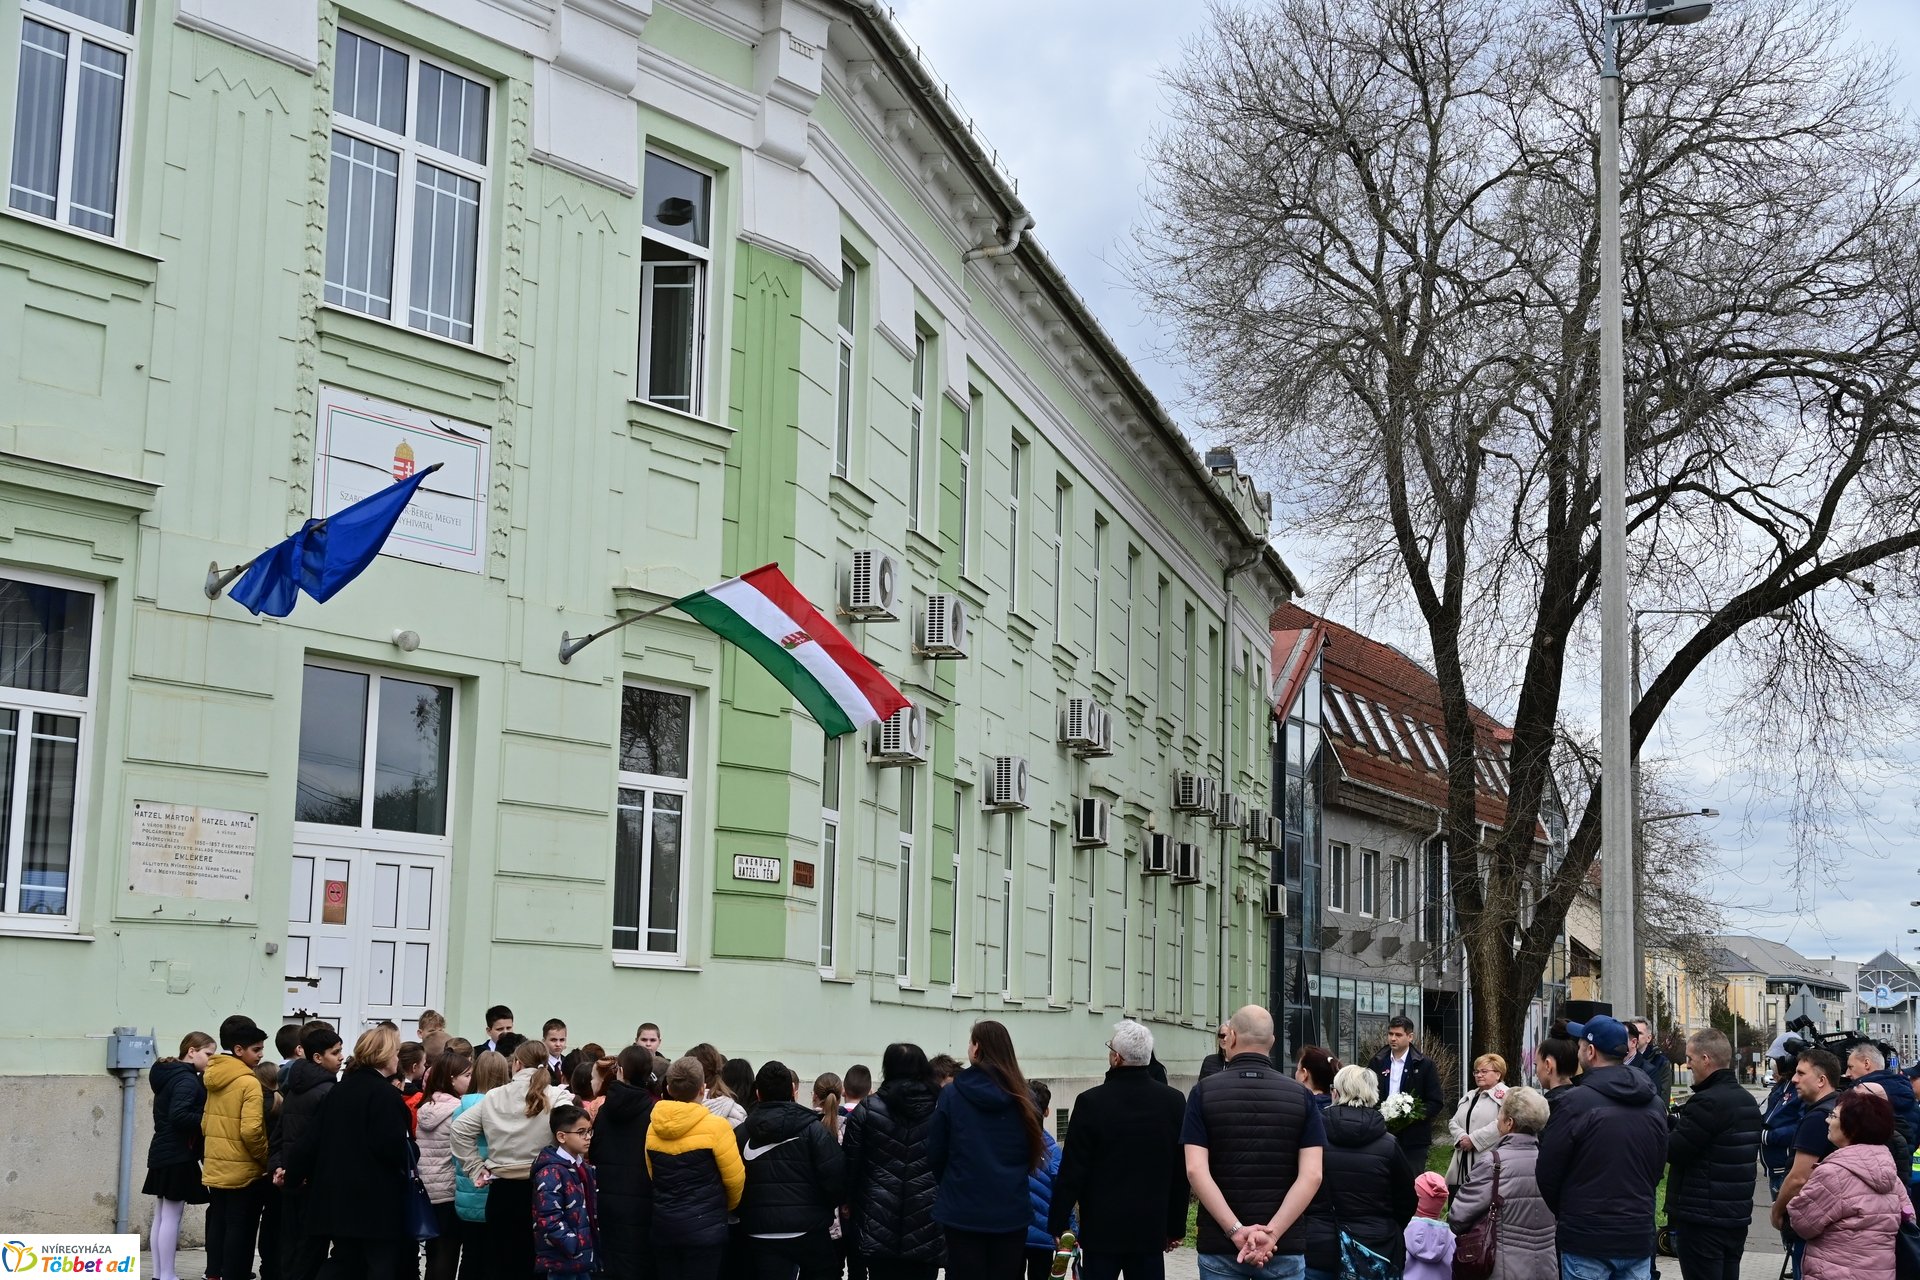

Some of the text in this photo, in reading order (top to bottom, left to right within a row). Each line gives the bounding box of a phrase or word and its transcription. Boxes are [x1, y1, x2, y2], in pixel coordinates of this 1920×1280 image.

[402, 507, 433, 520] R-BEREG
[435, 512, 462, 527] MEGYEI
[398, 517, 433, 531] NYHIVATAL
[134, 810, 162, 819] HATZEL
[202, 817, 227, 826] HATZEL
